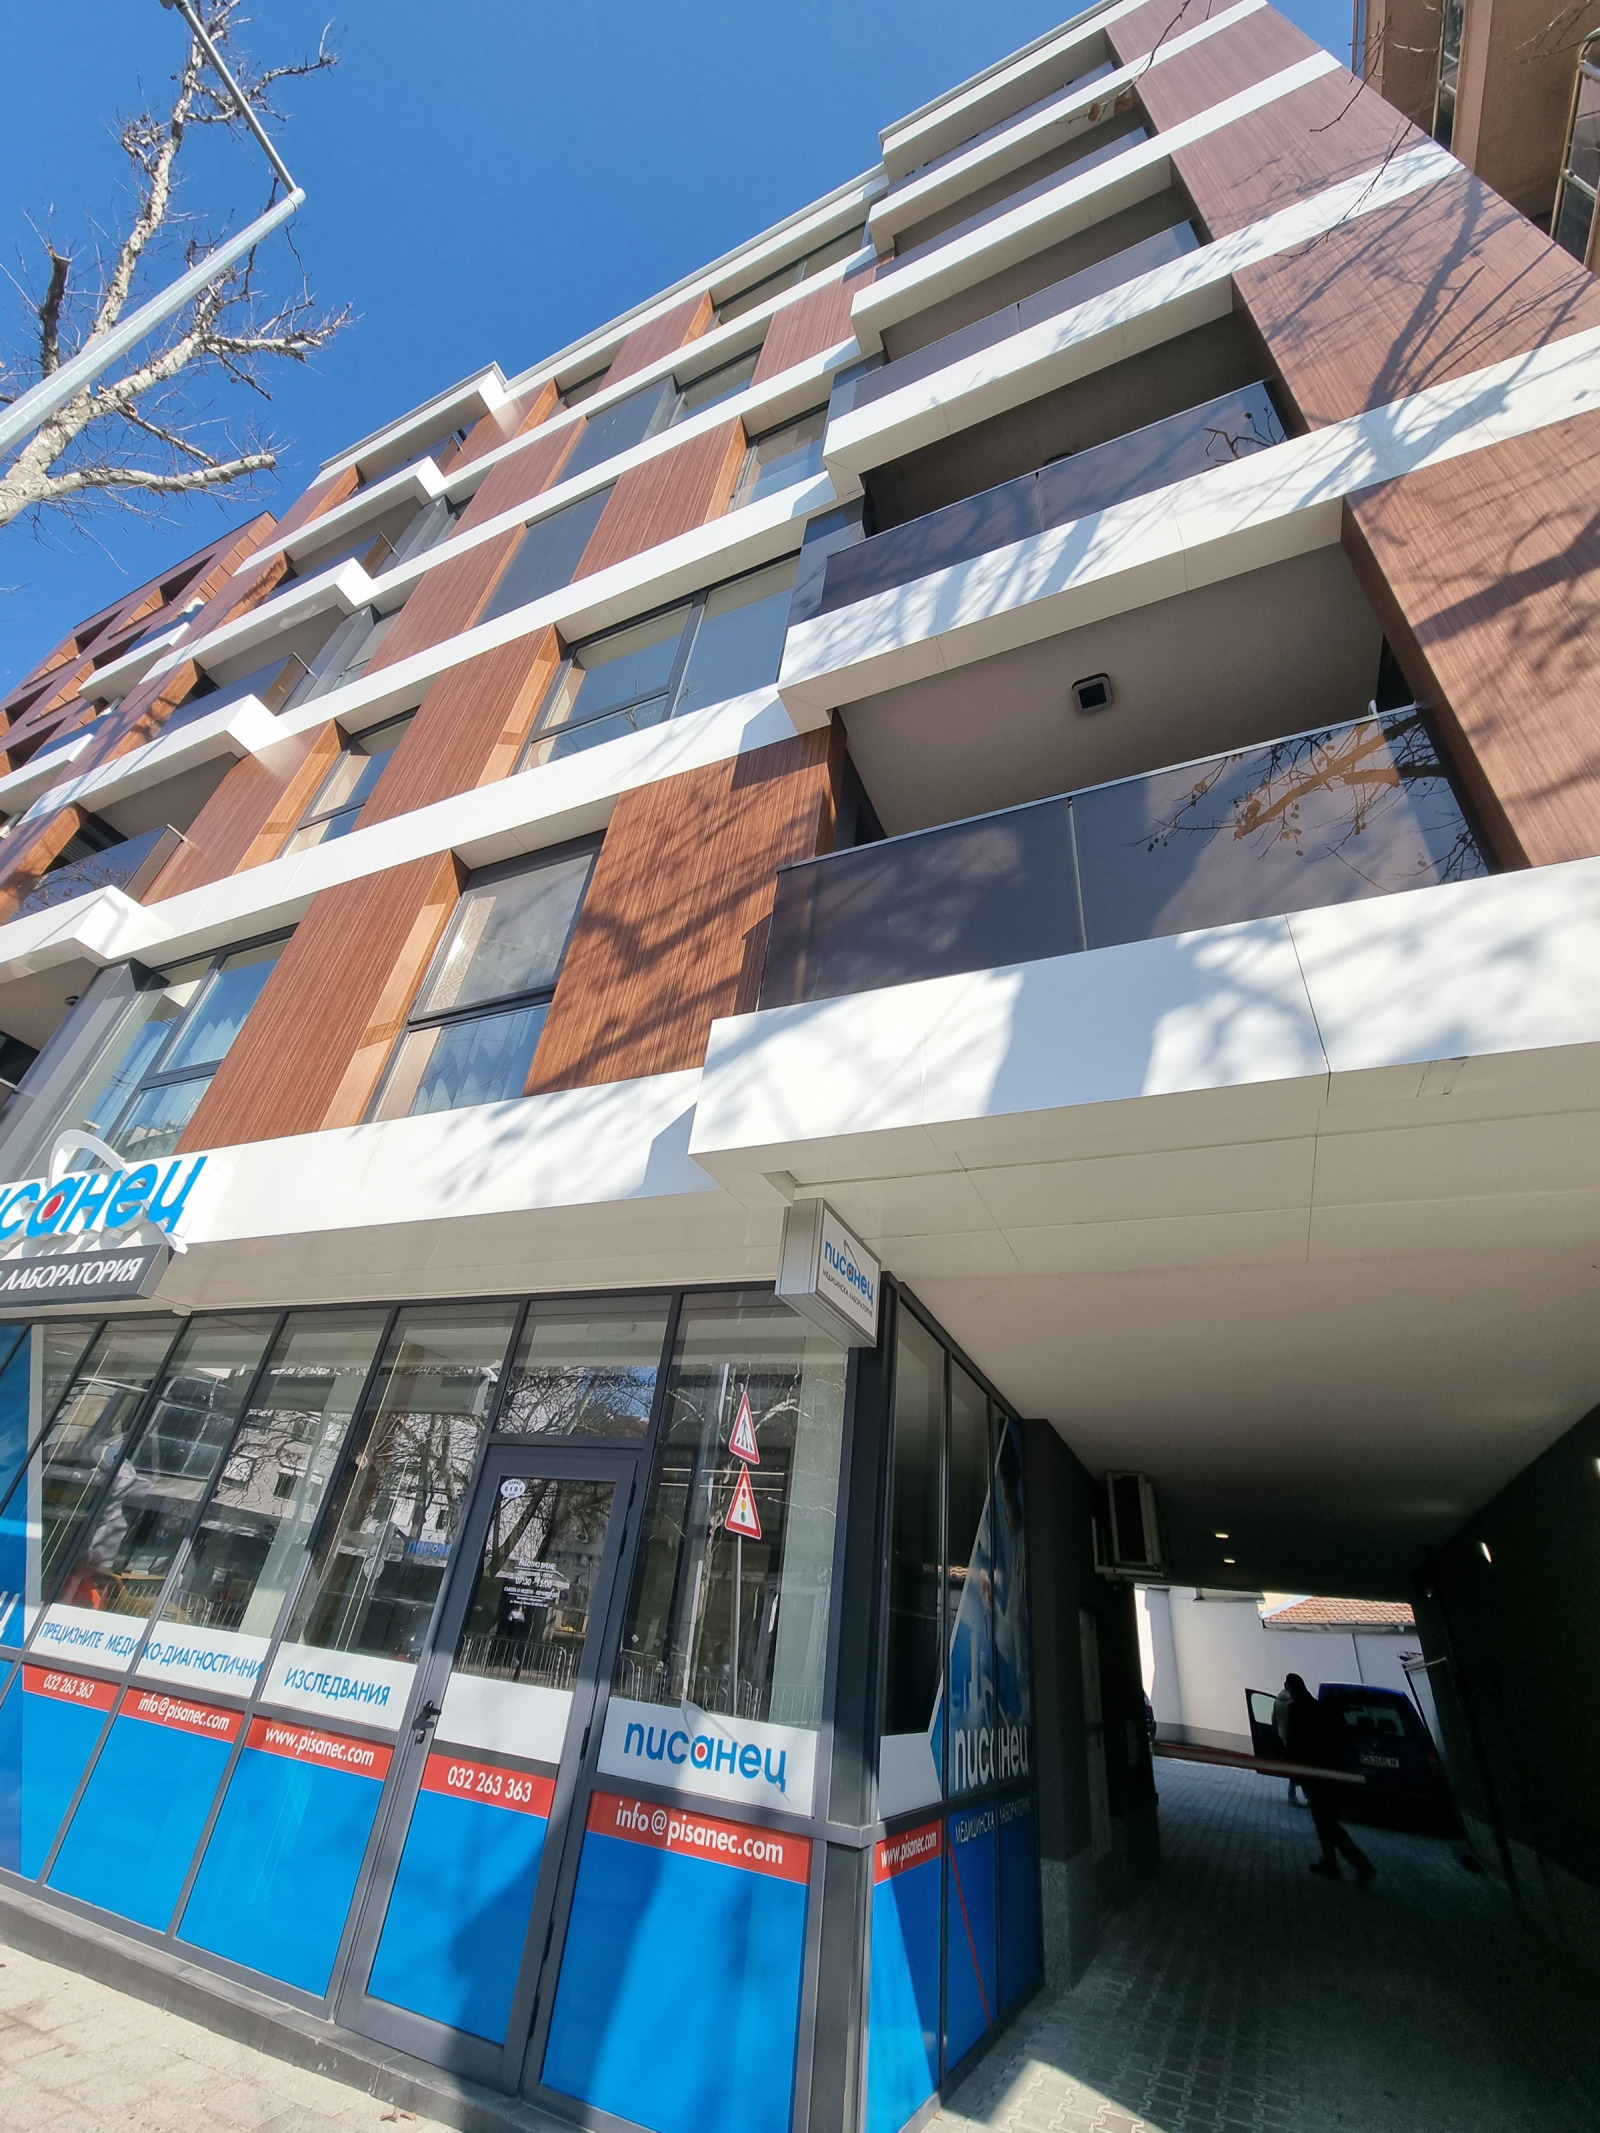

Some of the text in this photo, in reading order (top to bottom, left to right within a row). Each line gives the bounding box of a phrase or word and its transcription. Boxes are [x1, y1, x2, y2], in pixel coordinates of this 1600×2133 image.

[0, 1156, 208, 1241] санец
[0, 1257, 143, 1290] ЛАБОРАТОРИЯ
[825, 1241, 874, 1306] писанец
[39, 1622, 104, 1649] ПРЕЦИЗНИТЕ
[284, 1667, 391, 1707] ИЗСЛЕДВАНИЯ
[43, 1673, 95, 1699] 032 263 363
[138, 1692, 230, 1732] info@pisanec.com
[266, 1727, 375, 1767] www.pisanec.com
[624, 1722, 787, 1793] писанец
[447, 1765, 533, 1803] 032 263 363
[616, 1801, 783, 1865] info@pisanec.com
[881, 1832, 937, 1869] www.pisanec.com
